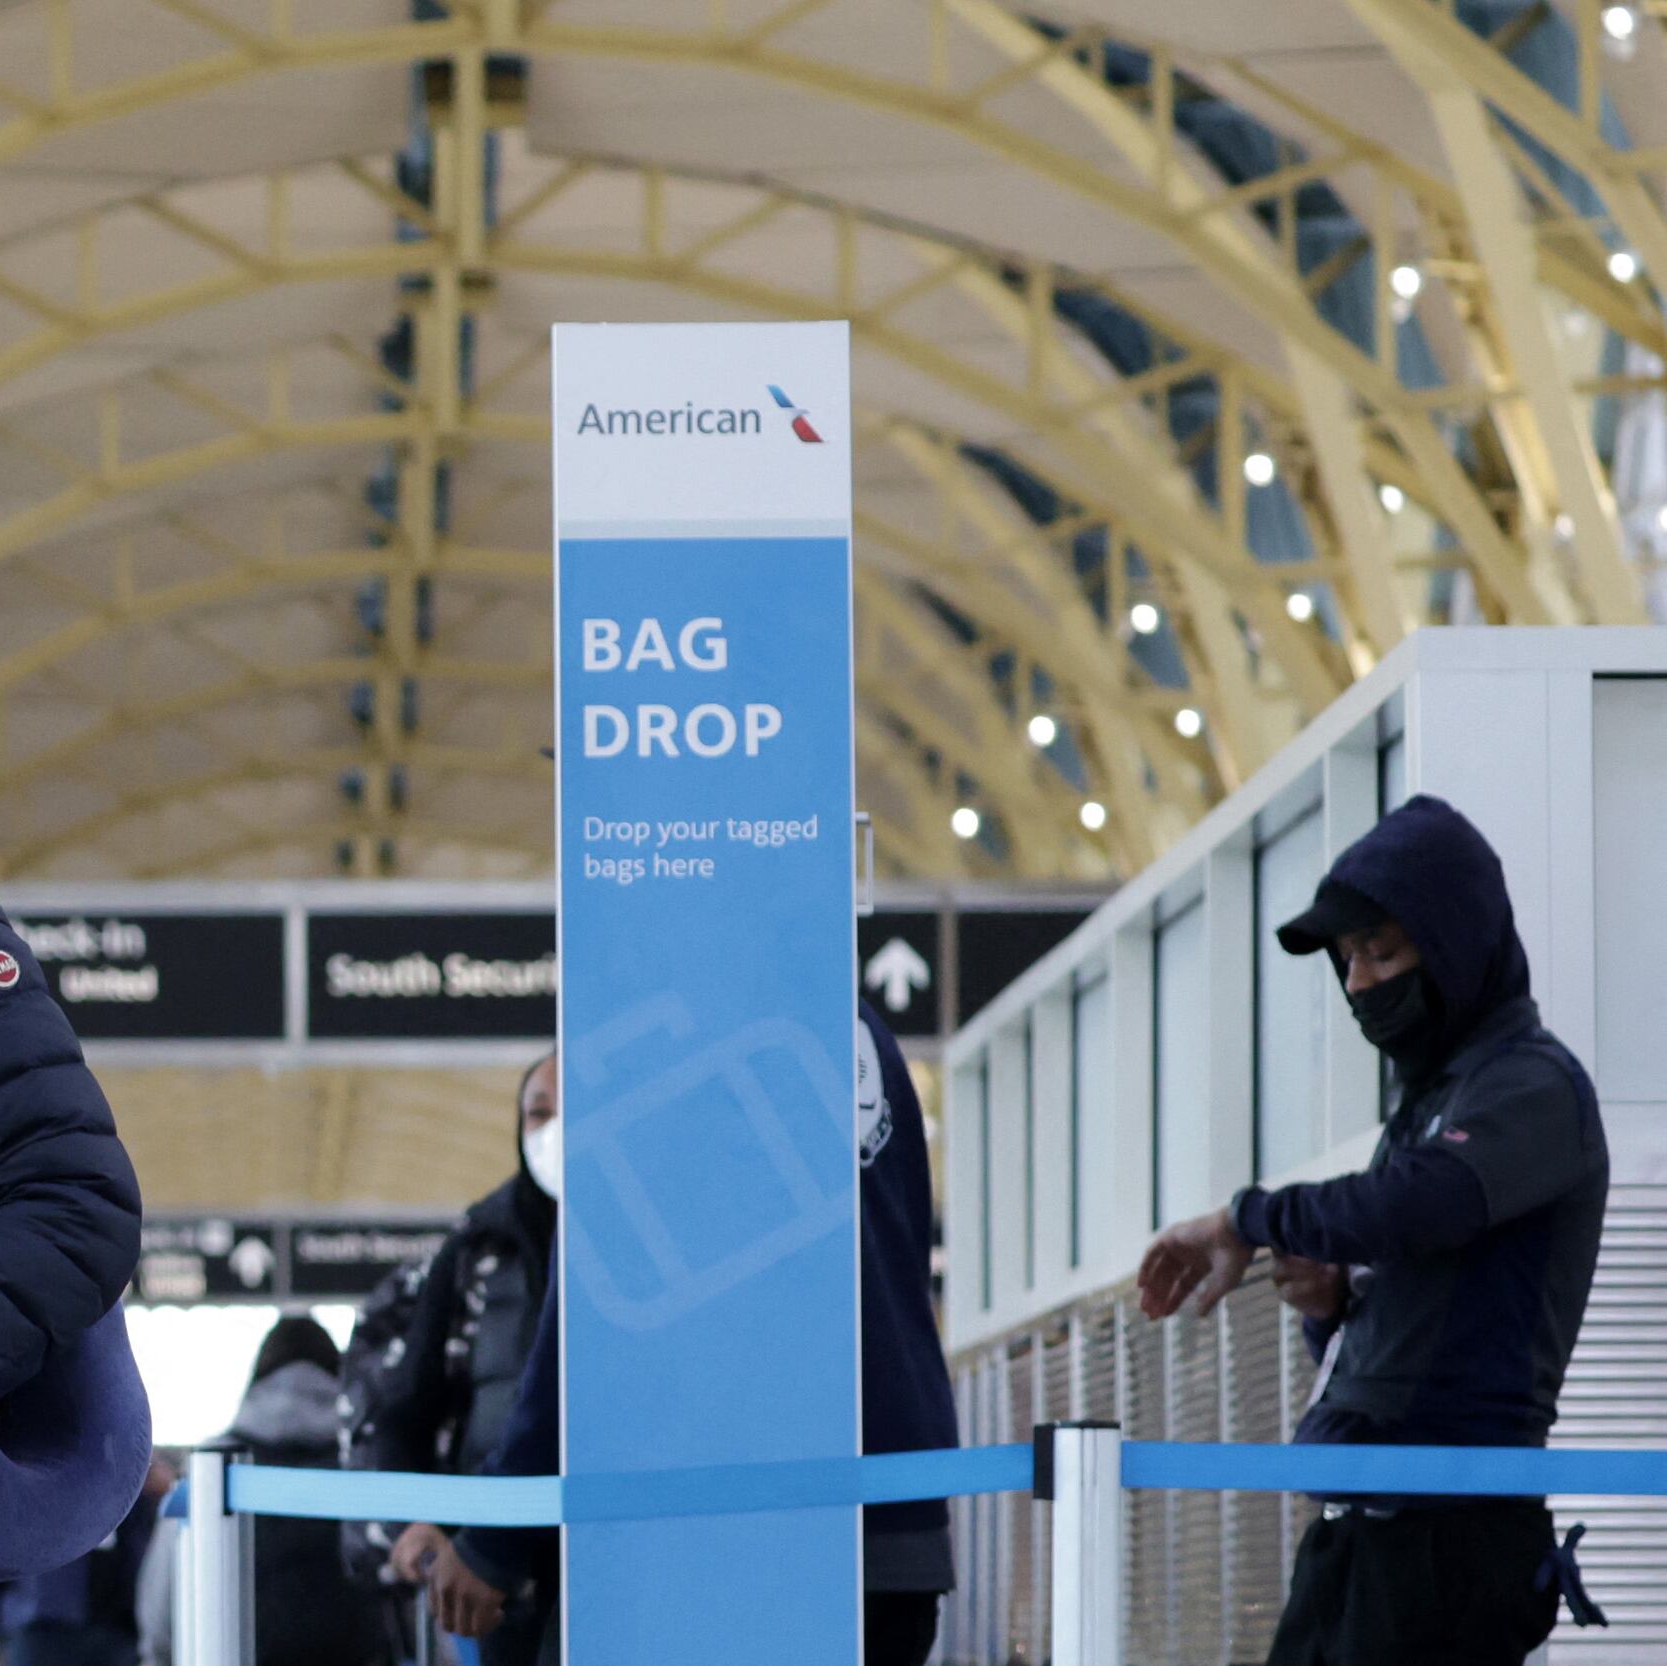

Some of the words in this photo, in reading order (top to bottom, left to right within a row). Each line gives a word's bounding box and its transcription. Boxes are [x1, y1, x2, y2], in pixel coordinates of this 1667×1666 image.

[577, 401, 762, 435] American
[582, 616, 728, 672] BAG
[583, 702, 783, 758] DROP
[584, 816, 651, 846] Drop
[657, 820, 720, 848] your
[727, 814, 818, 847] tagged
[584, 853, 645, 886] bags
[653, 853, 715, 878] here
[13, 918, 147, 961] eck-in
[324, 950, 441, 998] South
[442, 950, 556, 998] Securi
